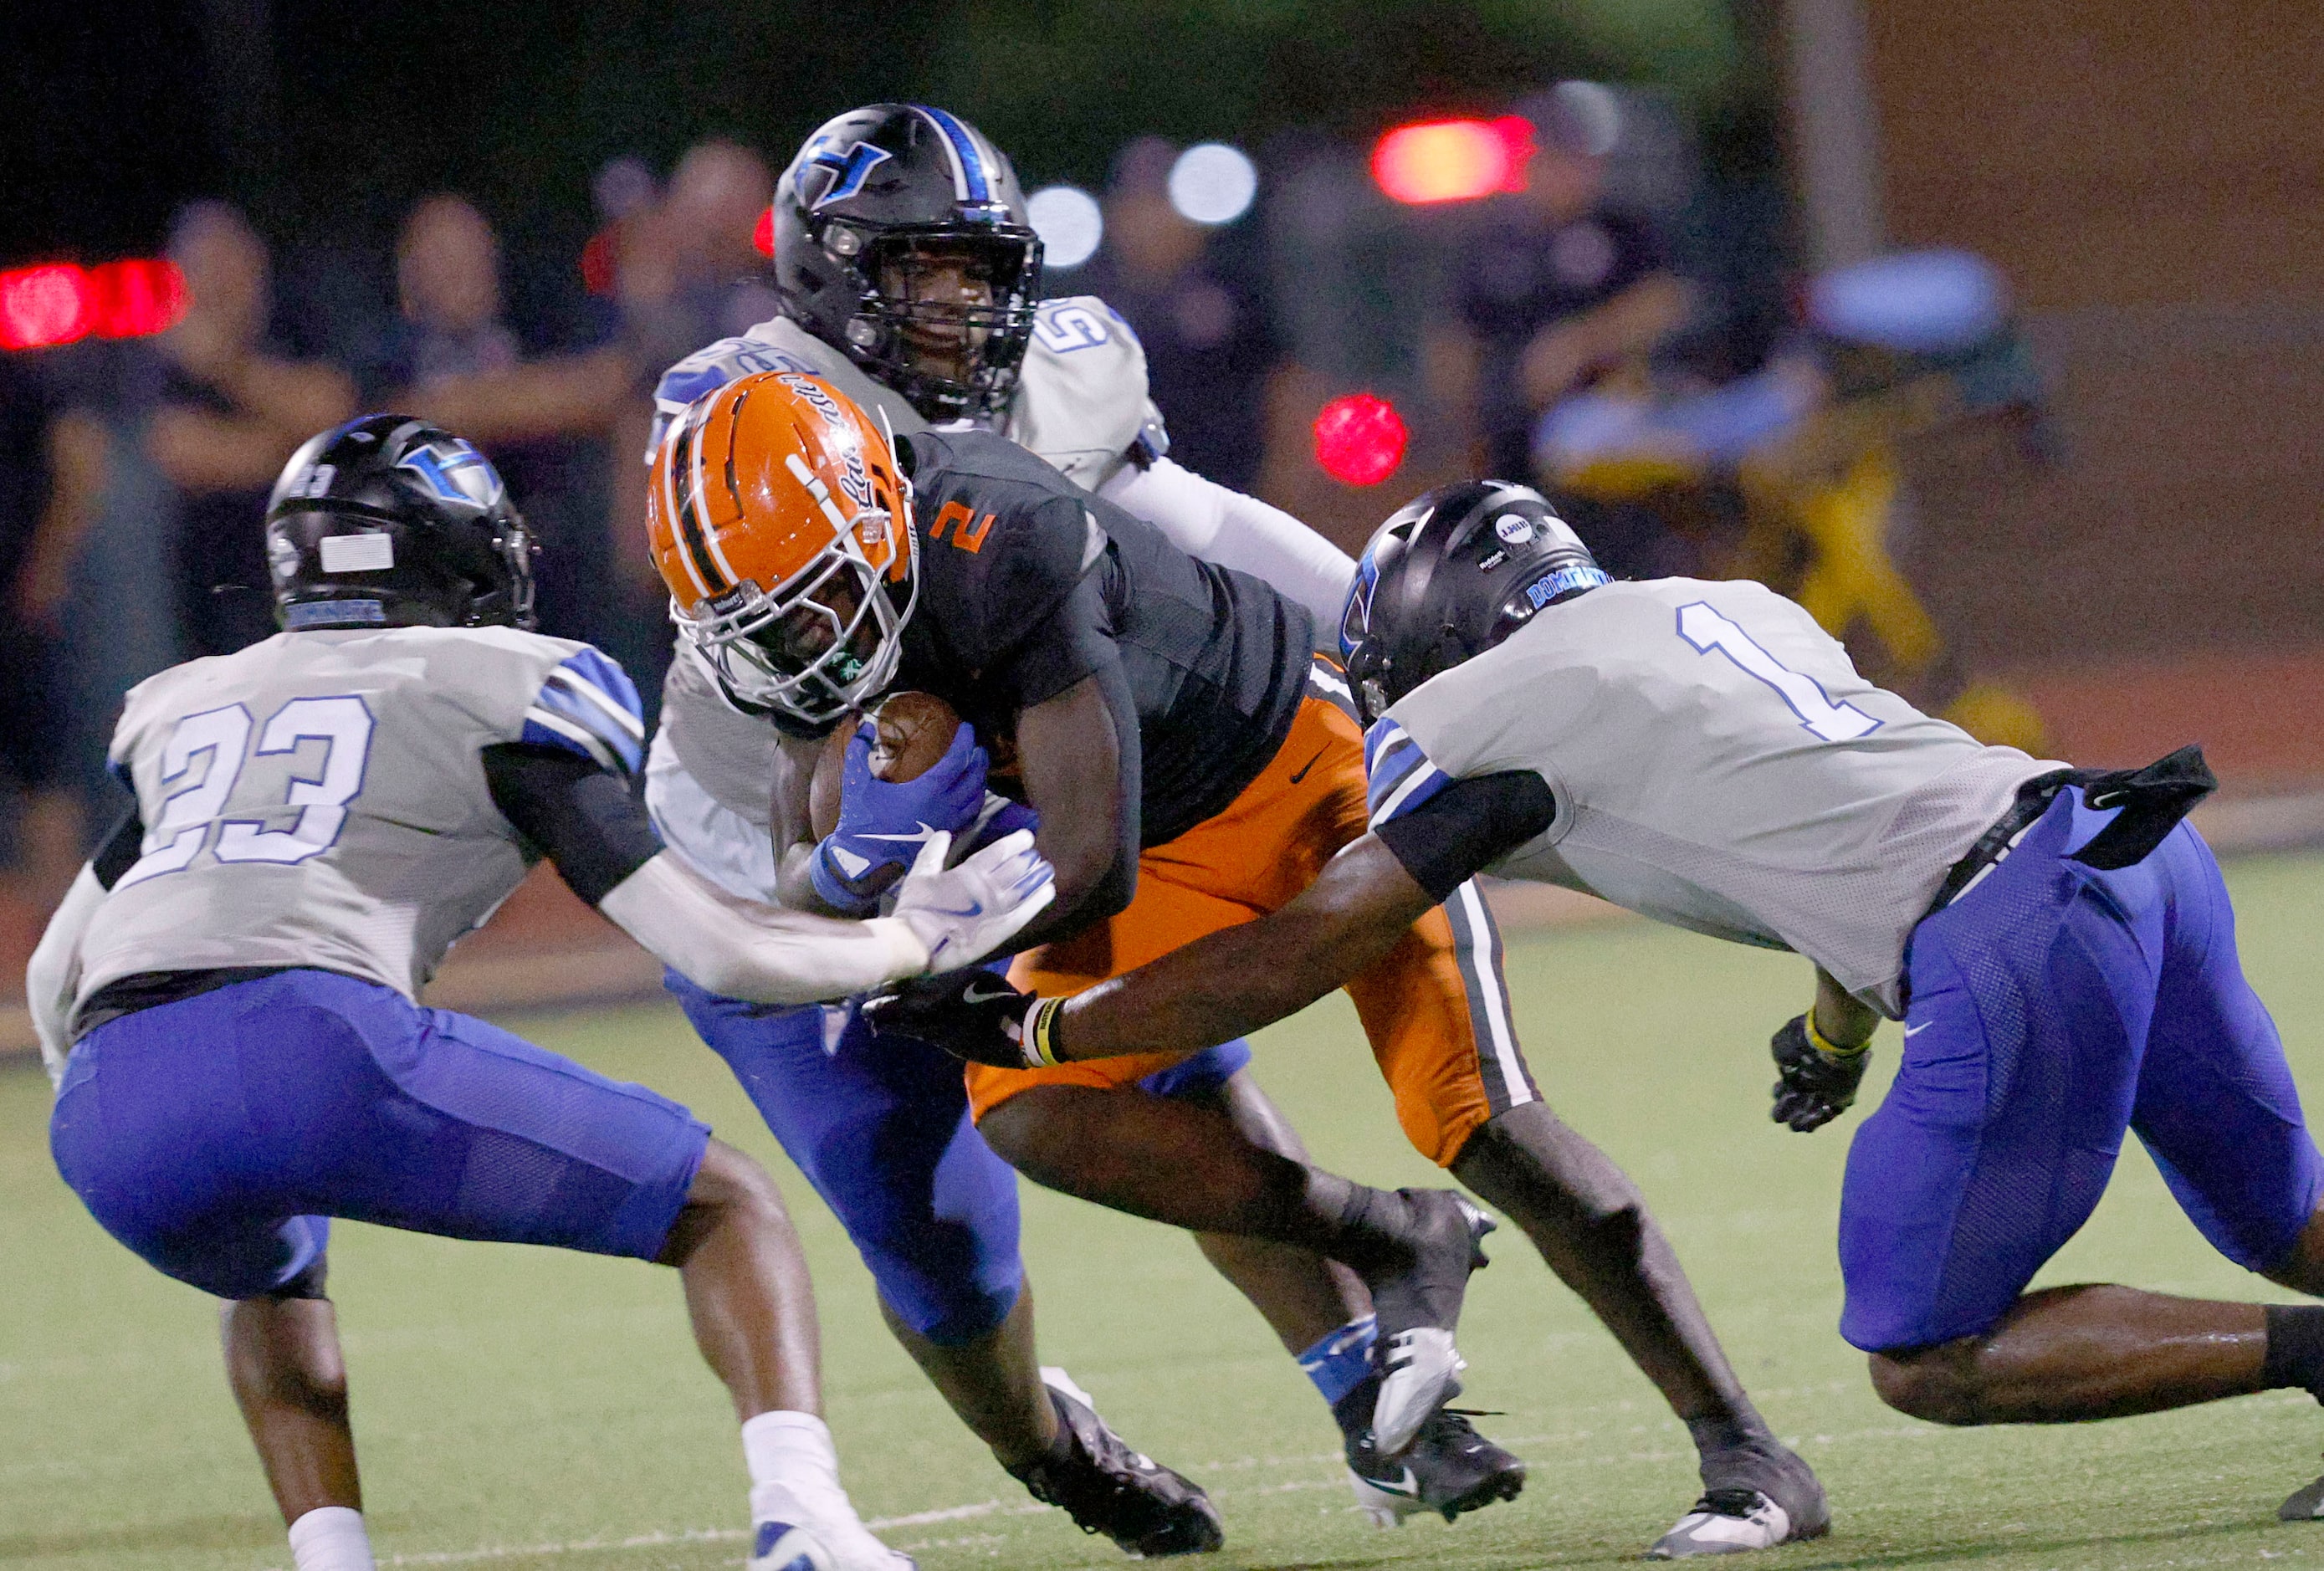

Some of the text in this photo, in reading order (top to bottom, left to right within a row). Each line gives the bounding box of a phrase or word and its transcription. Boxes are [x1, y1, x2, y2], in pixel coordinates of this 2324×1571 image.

[929, 500, 997, 555] 2
[1676, 601, 1885, 742] 1
[107, 693, 376, 893] 23
